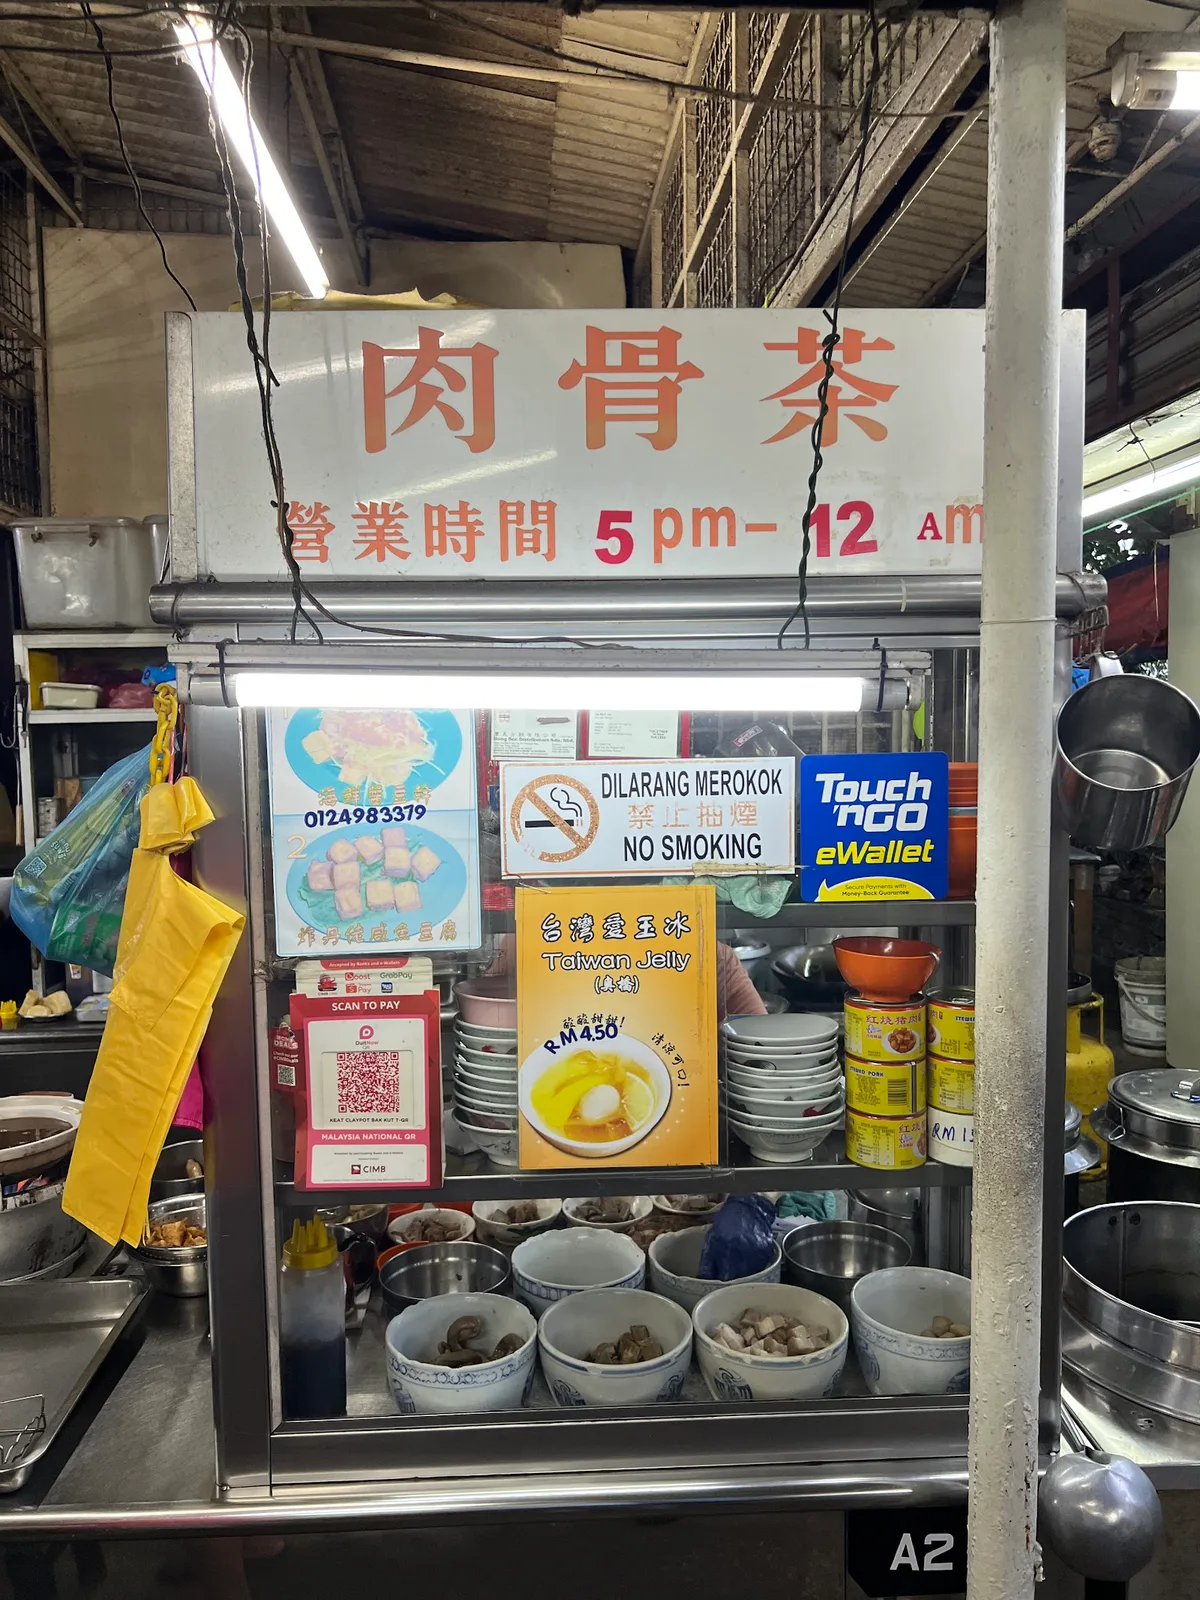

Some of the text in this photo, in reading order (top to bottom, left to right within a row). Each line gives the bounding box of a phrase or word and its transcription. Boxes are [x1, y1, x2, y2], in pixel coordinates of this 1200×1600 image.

[362, 326, 899, 452] 肉骨茶
[278, 500, 557, 563] 營業時間
[594, 510, 634, 565] 5
[807, 500, 878, 558] 12
[601, 768, 783, 799] DILARANG MEROKOK
[815, 771, 932, 804] Touch
[304, 804, 427, 828] 0124983379
[627, 800, 758, 830] 禁止抽煙
[286, 835, 308, 859] 2
[623, 832, 763, 862] NO SMOKING
[815, 839, 935, 865] eWallet
[541, 910, 691, 943] 台灣愛玉冰
[541, 950, 691, 972] Taiwan Jelly
[380, 972, 413, 980] GrabPay
[358, 985, 372, 994] Pay
[332, 1001, 400, 1011] SCAN TO PAY
[273, 1040, 299, 1050] DEALS
[932, 1123, 955, 1141] RM
[363, 1165, 386, 1173] CIMB
[889, 1532, 954, 1571] A2
